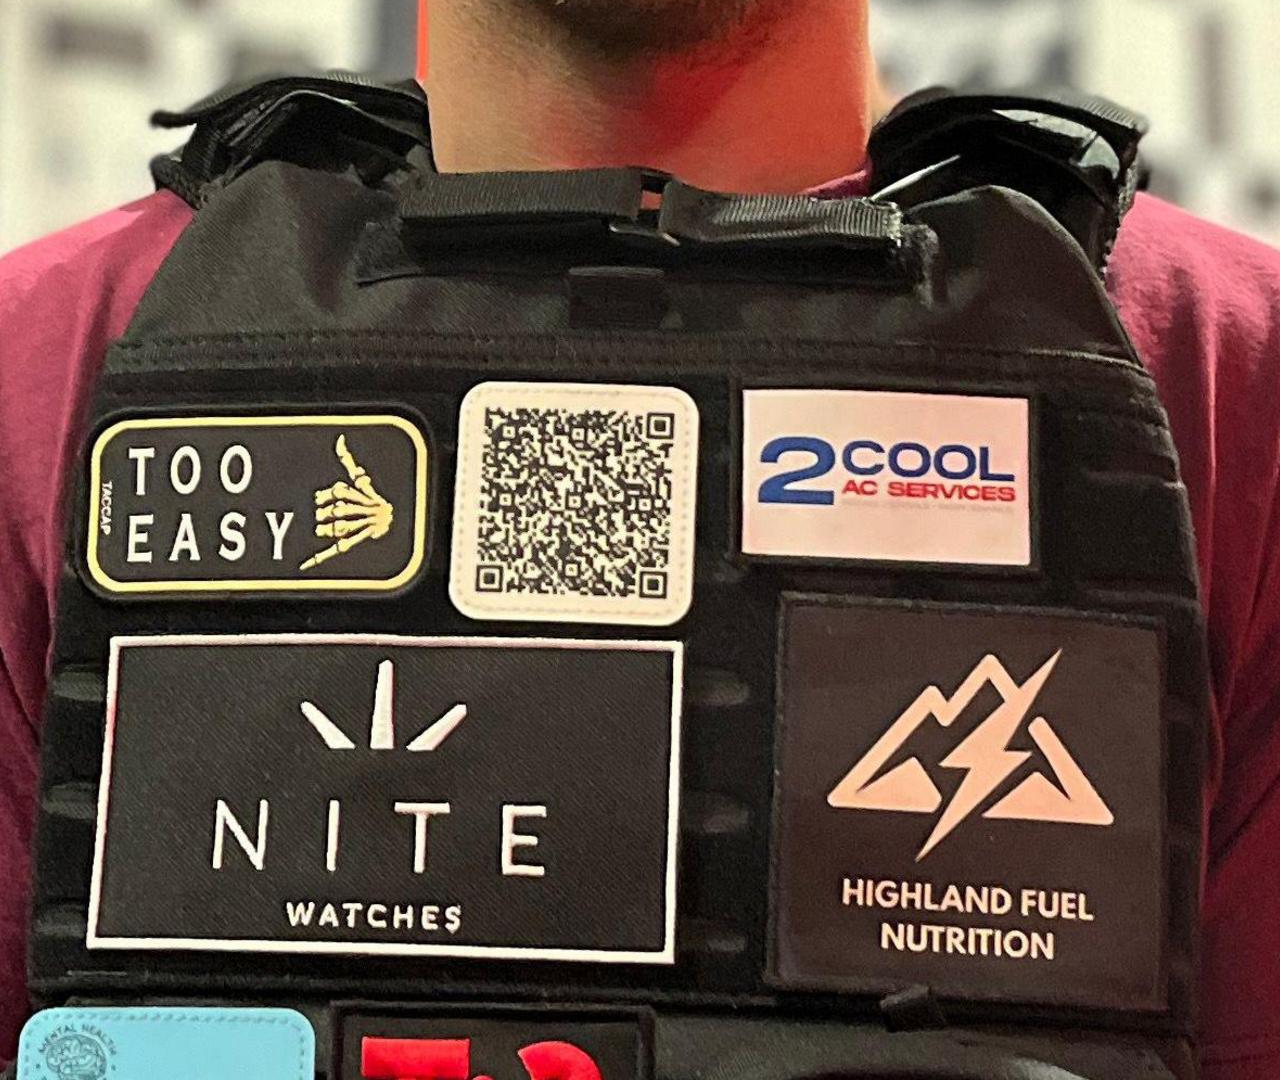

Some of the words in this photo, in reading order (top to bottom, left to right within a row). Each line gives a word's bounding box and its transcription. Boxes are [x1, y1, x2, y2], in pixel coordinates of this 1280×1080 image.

[128, 444, 253, 496] TOO
[757, 436, 836, 506] 2
[842, 440, 1016, 482] COOL
[842, 479, 878, 497] AC
[887, 481, 1017, 503] SERVICES
[100, 480, 113, 536] TACCAP
[126, 511, 295, 564] EASY
[212, 799, 548, 877] NITE
[286, 901, 462, 934] WATCHES
[842, 877, 1013, 916] HIGHLAND
[1020, 888, 1095, 921] FUEL
[881, 922, 1055, 961] NUTRITION
[38, 1023, 77, 1054] MENTAL
[81, 1023, 117, 1056] HEALTH
